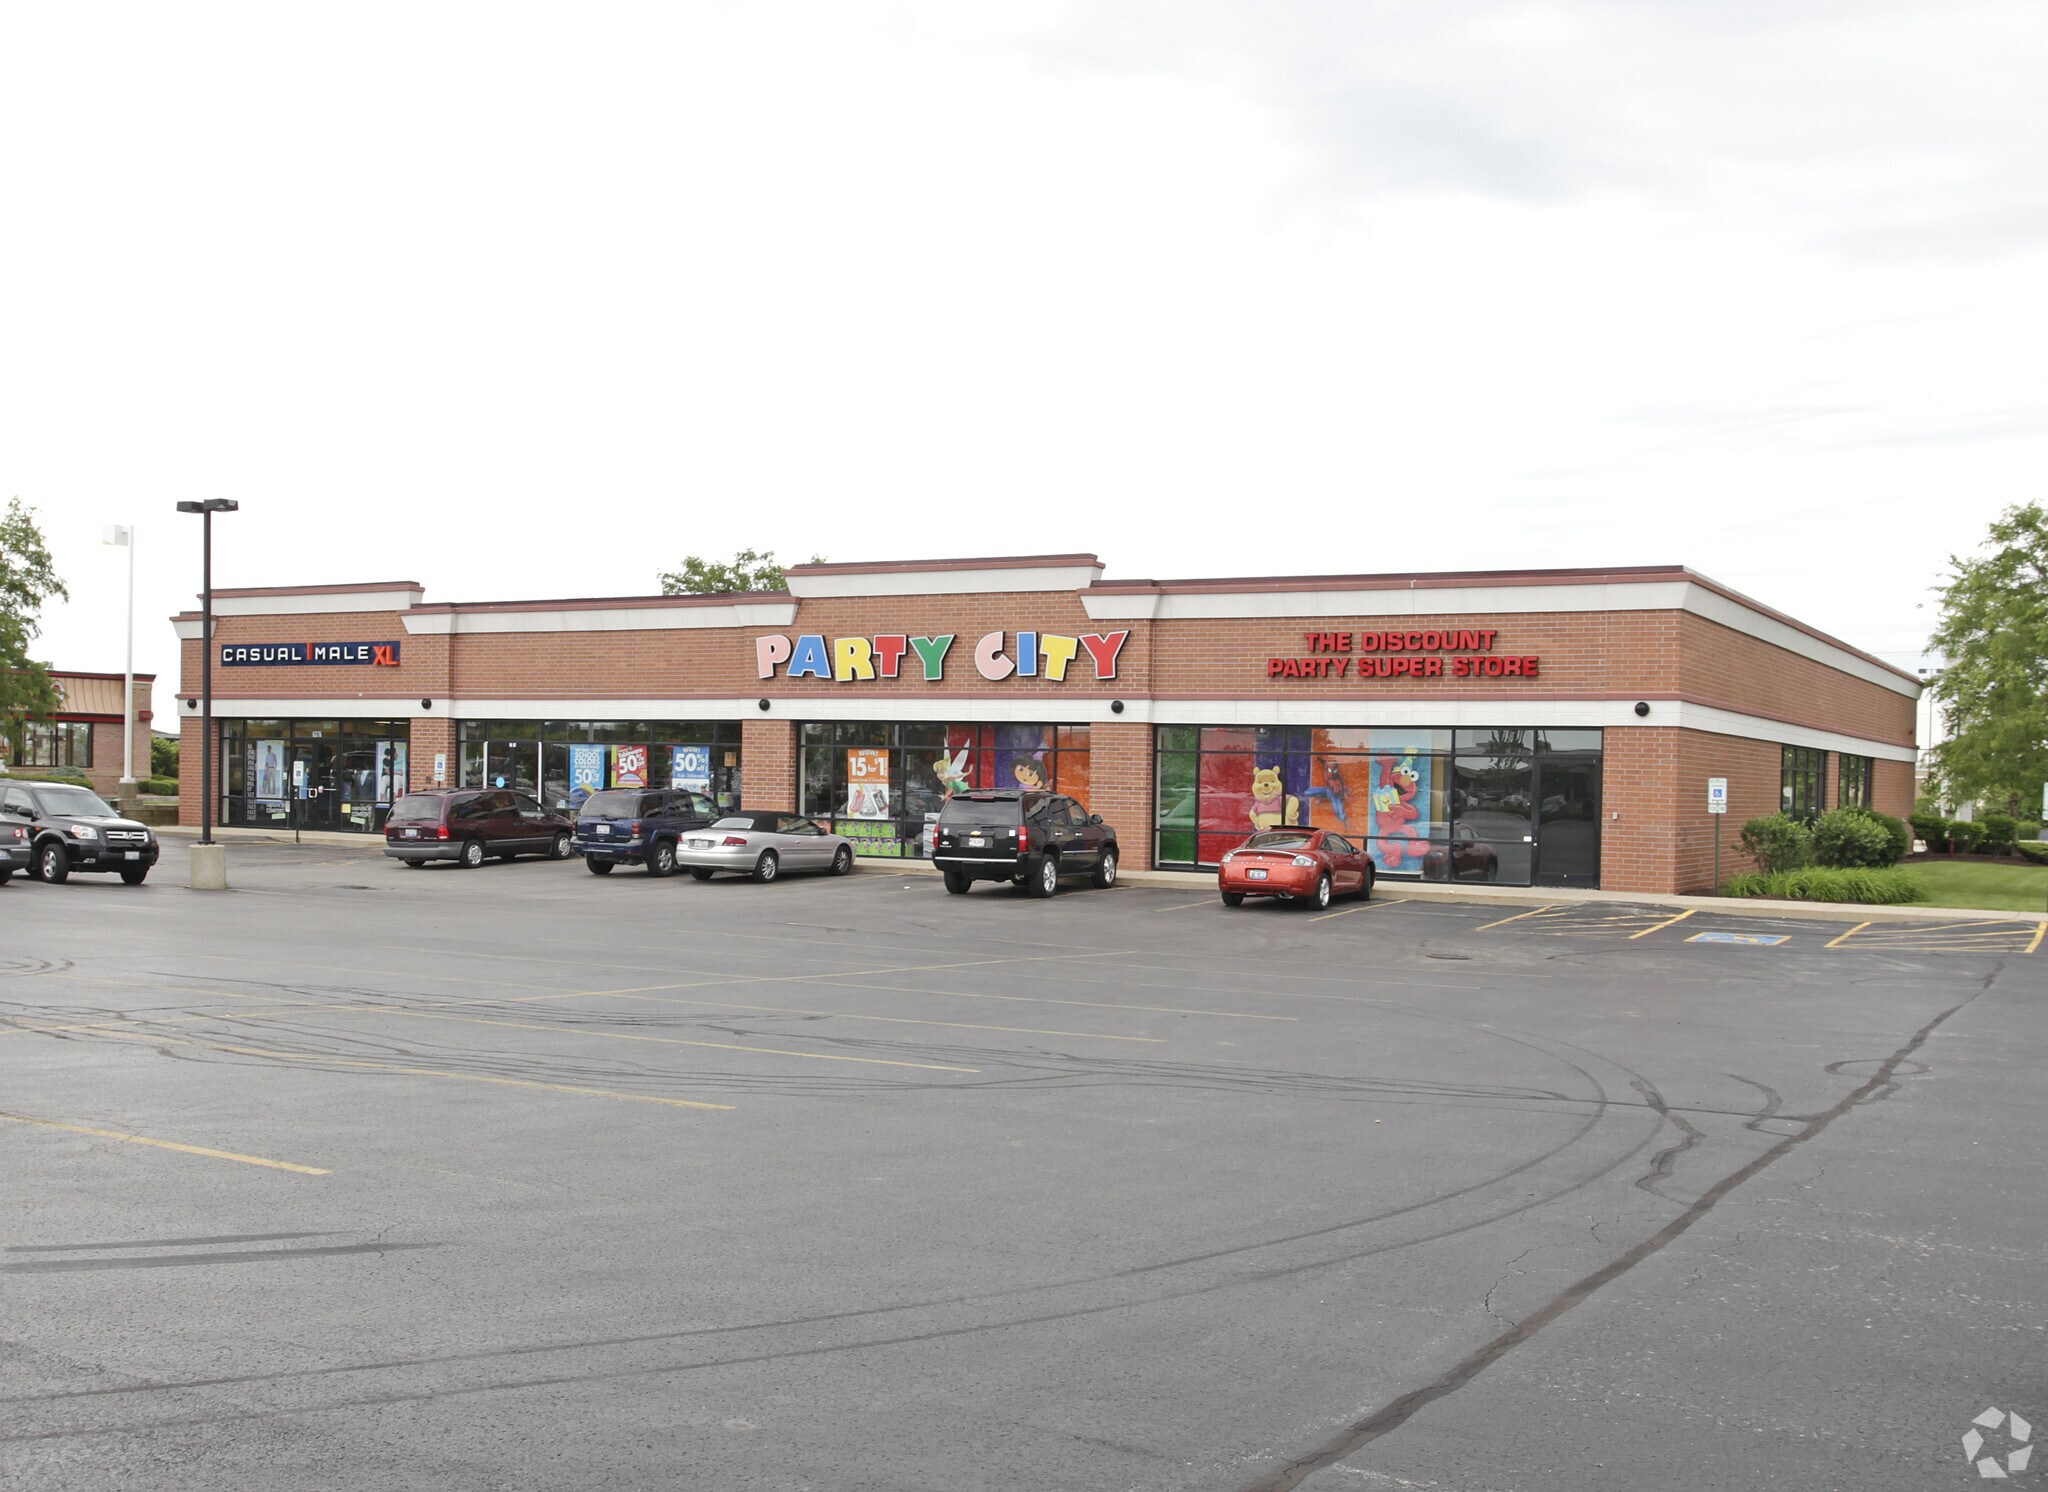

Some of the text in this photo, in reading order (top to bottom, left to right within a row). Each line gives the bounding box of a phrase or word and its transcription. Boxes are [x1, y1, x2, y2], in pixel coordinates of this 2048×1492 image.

[1305, 630, 1497, 652] THE DISCOUNT
[222, 645, 400, 666] CASUAL MALE XL
[755, 629, 1131, 683] PARTY CITY
[1267, 656, 1539, 678] PARTY SUPER STORE
[674, 752, 706, 772] 50%
[858, 749, 879, 757] WOW!
[849, 757, 867, 777] 15
